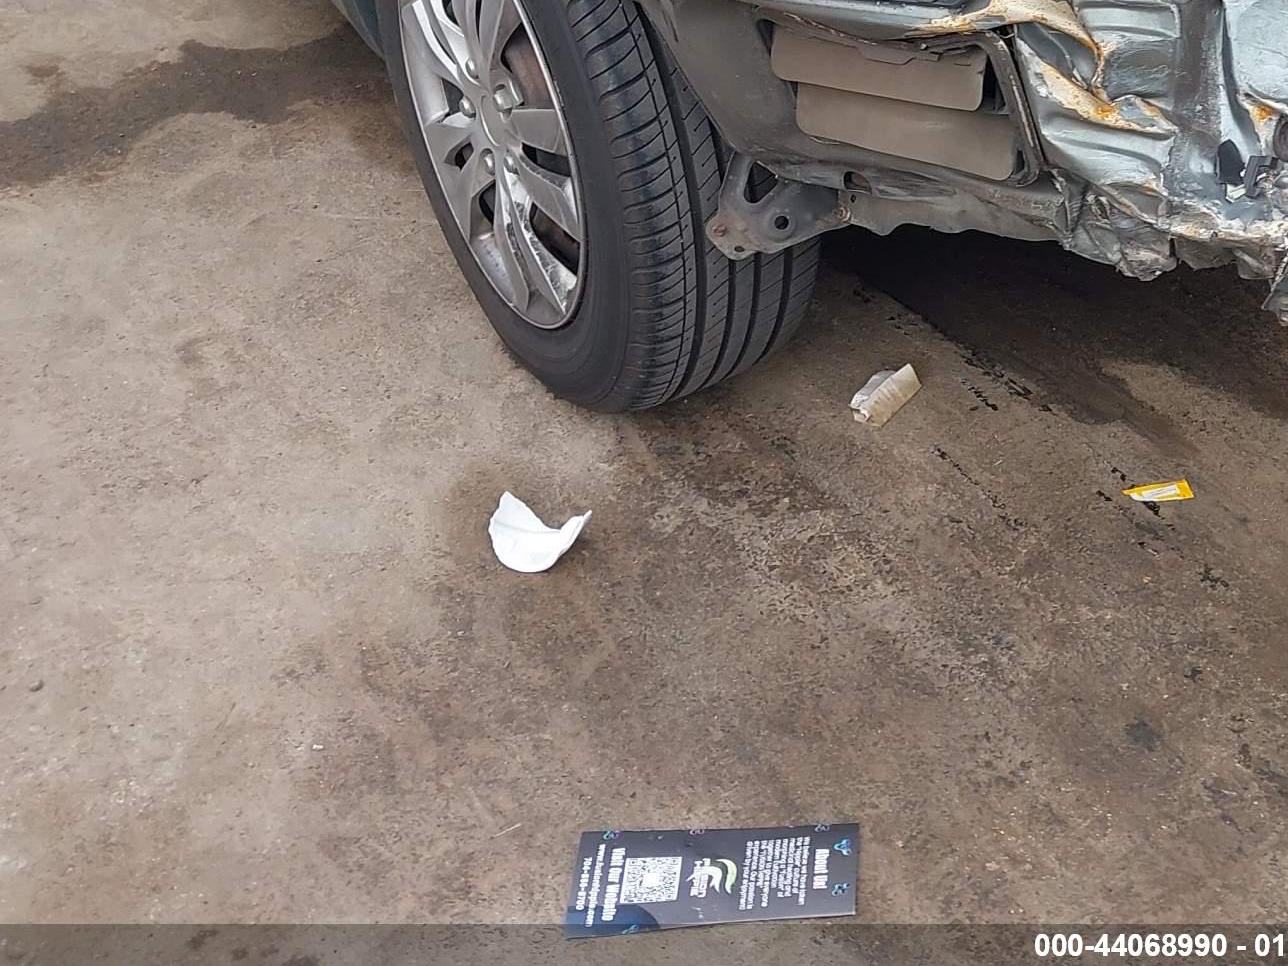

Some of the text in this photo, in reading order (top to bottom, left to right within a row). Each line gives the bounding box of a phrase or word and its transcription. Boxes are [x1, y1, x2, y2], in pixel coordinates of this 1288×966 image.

[602, 848, 626, 921] Visit Our Website
[813, 849, 830, 874] About
